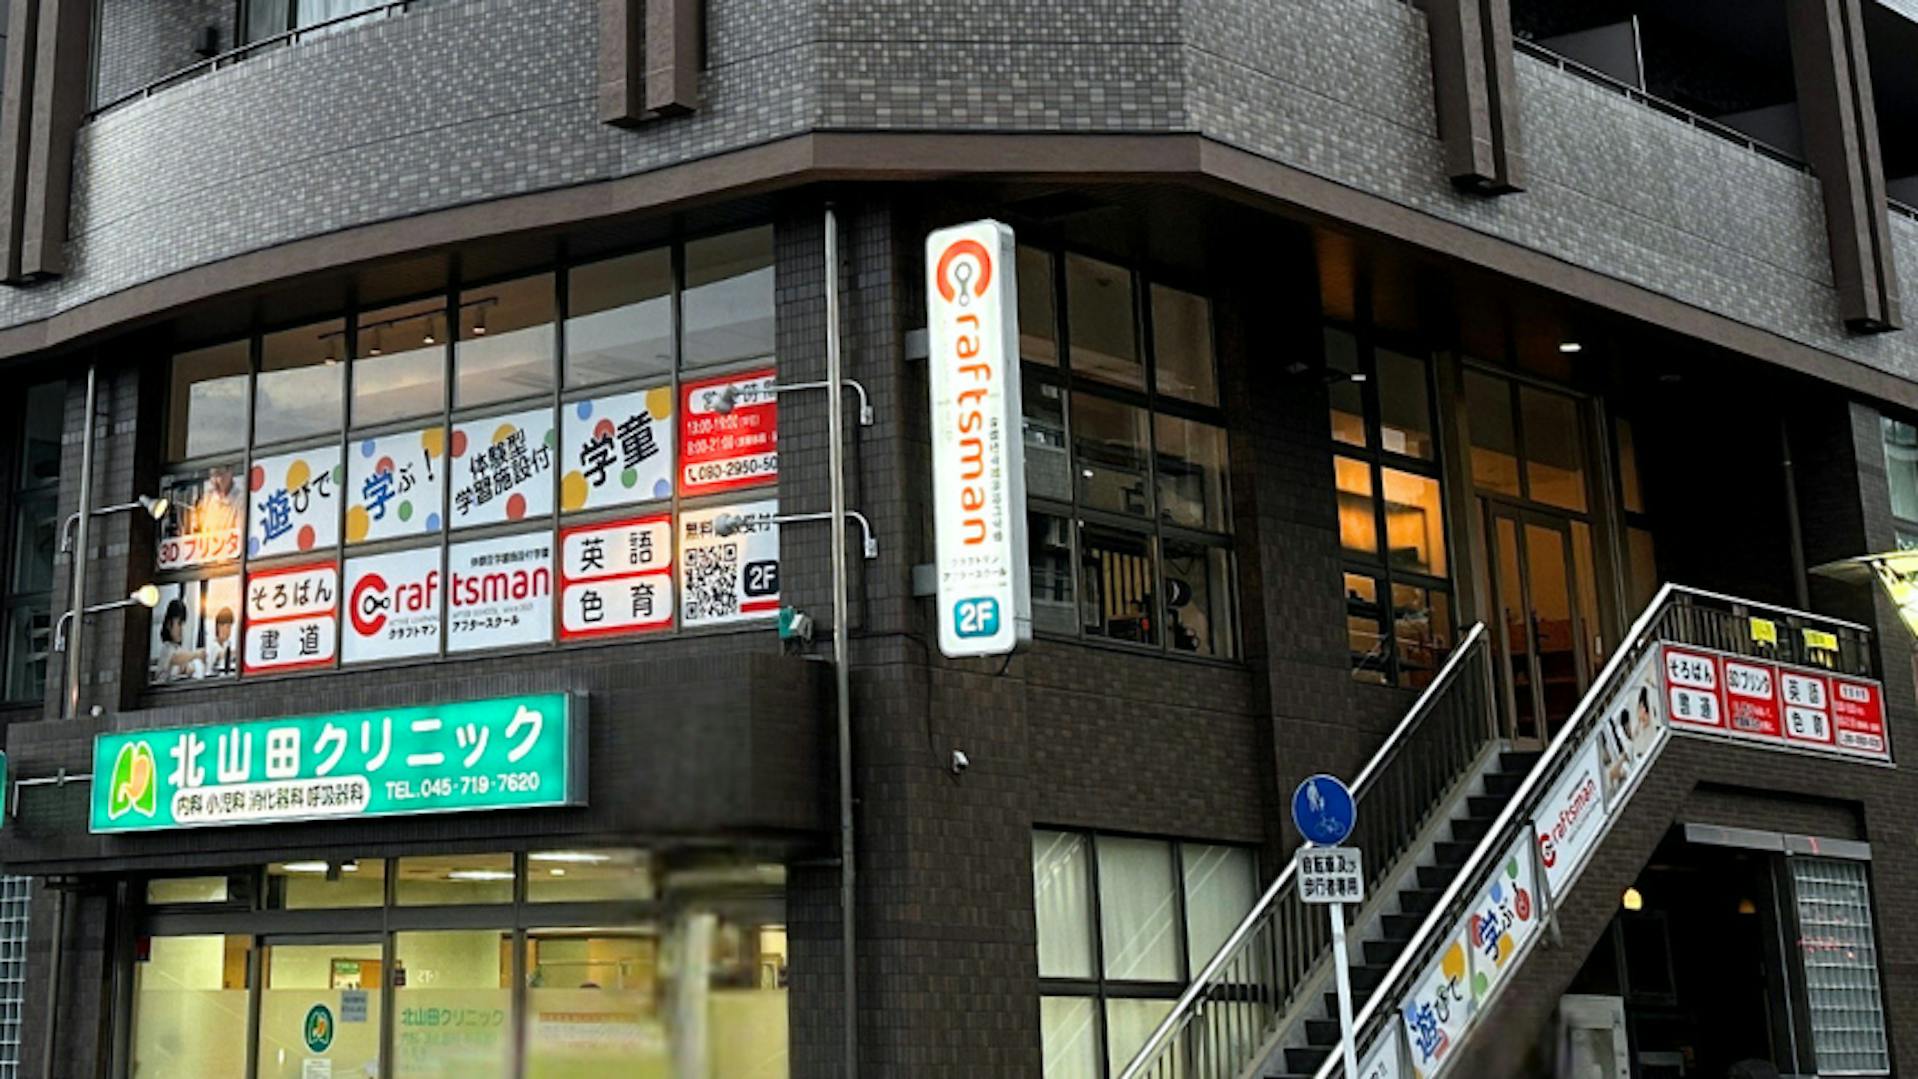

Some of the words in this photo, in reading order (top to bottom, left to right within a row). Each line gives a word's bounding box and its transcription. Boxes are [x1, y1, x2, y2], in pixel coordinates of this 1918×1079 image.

[470, 428, 526, 480] 体験型
[578, 411, 659, 488] 学童
[455, 444, 549, 516] 学習施設付
[258, 470, 331, 545] 遊びで
[581, 530, 653, 573] 英語
[252, 575, 332, 611] そろばん
[749, 563, 776, 590] 2F
[580, 583, 654, 624] 色育
[959, 602, 994, 633] 2F
[260, 625, 320, 660] 書道
[168, 705, 543, 789] 北山田クリニック
[401, 1007, 504, 1027] 北山田クリニック
[1410, 975, 1463, 1065] 遊びで
